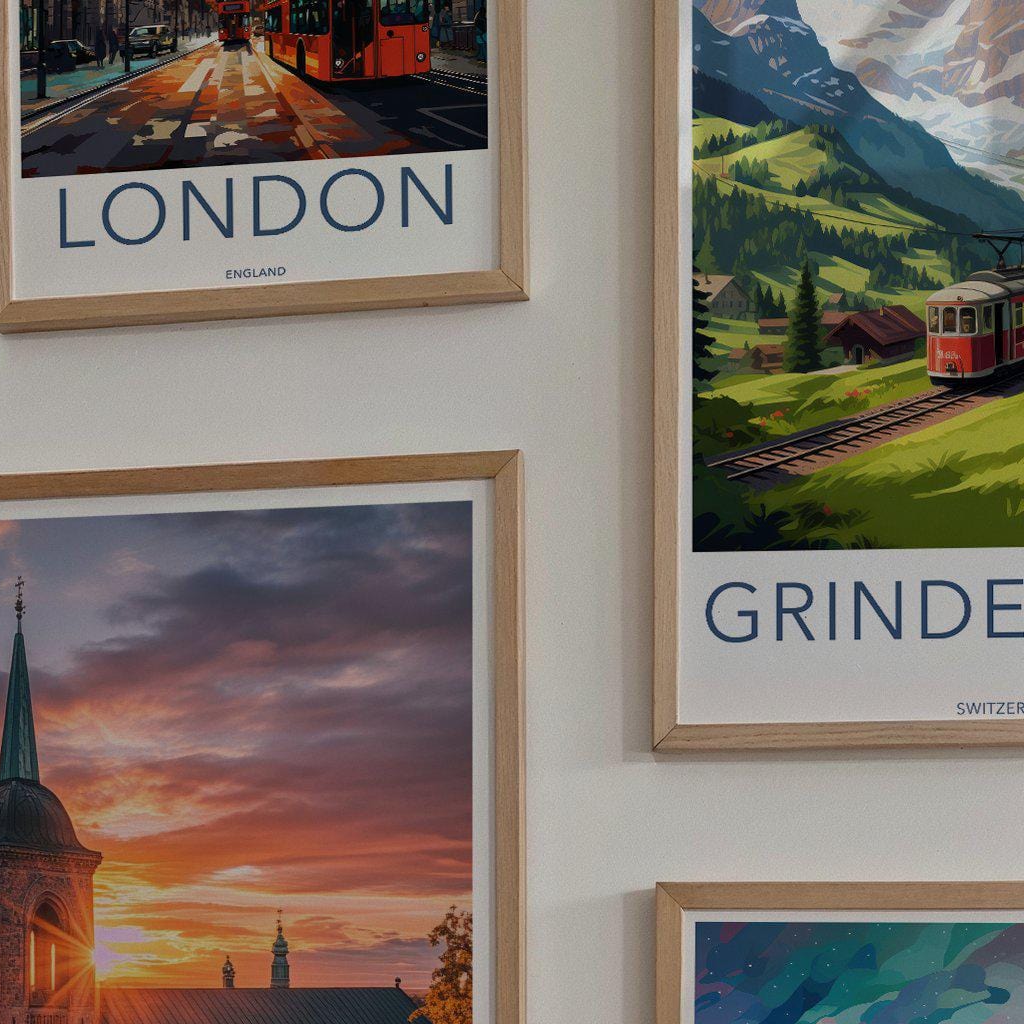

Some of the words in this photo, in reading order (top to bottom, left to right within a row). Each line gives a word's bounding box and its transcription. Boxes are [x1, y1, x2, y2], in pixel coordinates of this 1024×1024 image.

[59, 163, 454, 249] LONDON
[225, 266, 287, 279] ENGLAND
[705, 578, 1024, 644] GRINDE
[956, 701, 1024, 715] SWITZER
